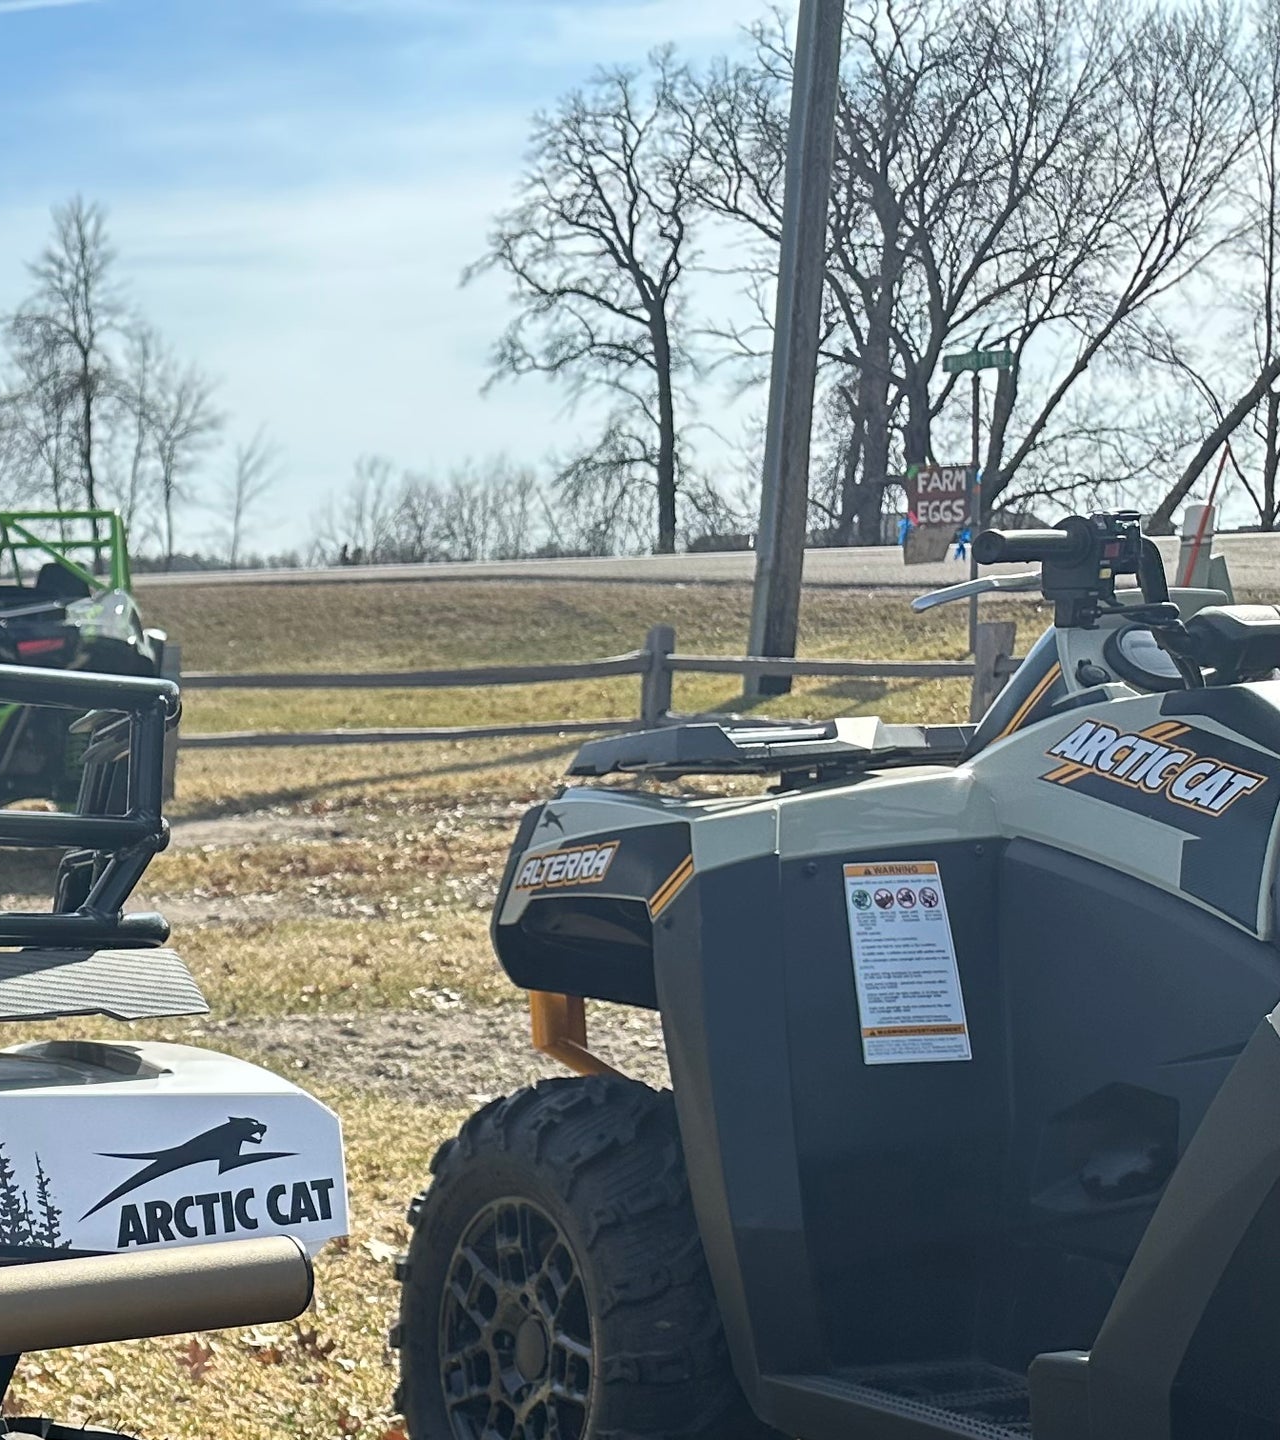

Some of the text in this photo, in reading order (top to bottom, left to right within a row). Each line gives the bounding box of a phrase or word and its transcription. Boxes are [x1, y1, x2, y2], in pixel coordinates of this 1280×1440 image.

[917, 469, 967, 493] FARM
[917, 499, 965, 523] EGGS
[1048, 719, 1261, 813] ARCTIC CAT
[517, 845, 617, 888] ALTERRA
[873, 864, 919, 875] WARNING
[117, 1177, 334, 1248] ARCTIC CAT
